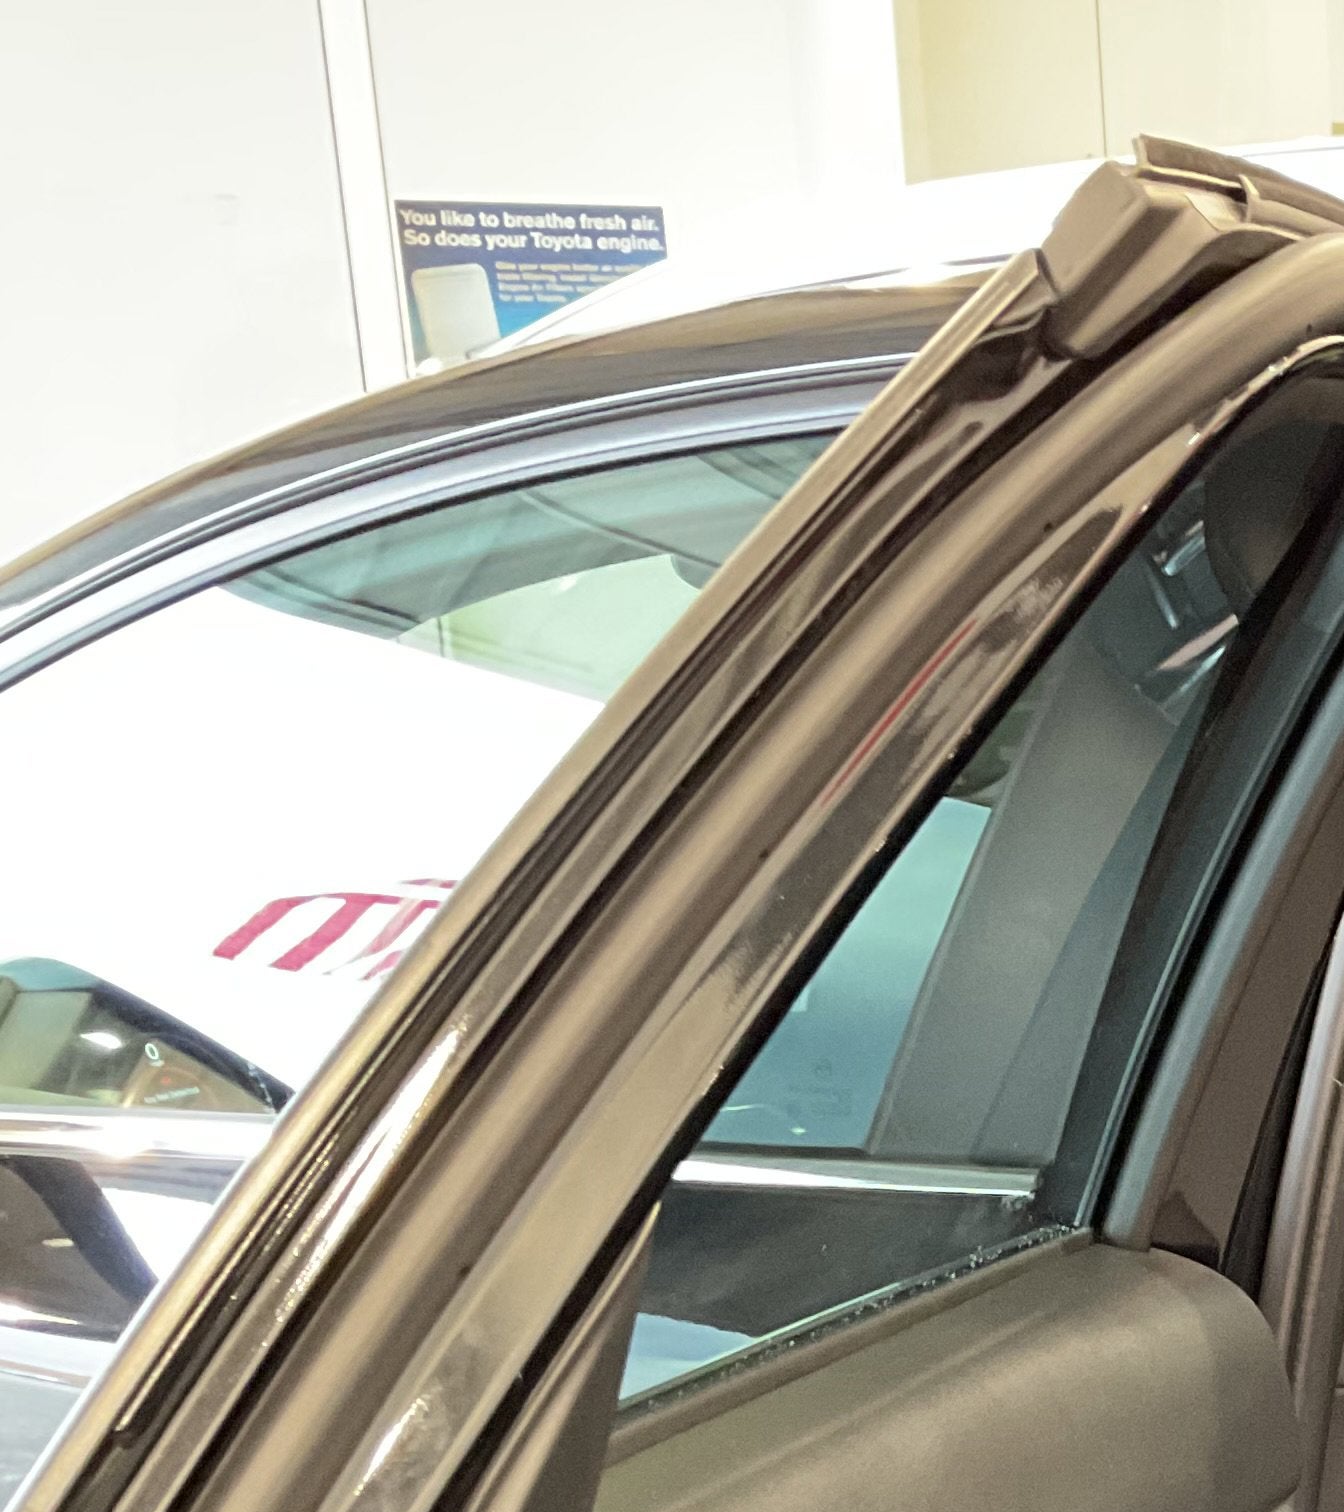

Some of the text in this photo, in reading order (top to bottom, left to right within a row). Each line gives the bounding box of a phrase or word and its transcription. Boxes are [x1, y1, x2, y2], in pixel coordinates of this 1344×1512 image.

[399, 209, 660, 231] You like to breathe fresh air.
[403, 230, 665, 254] So does your Toyota engine.
